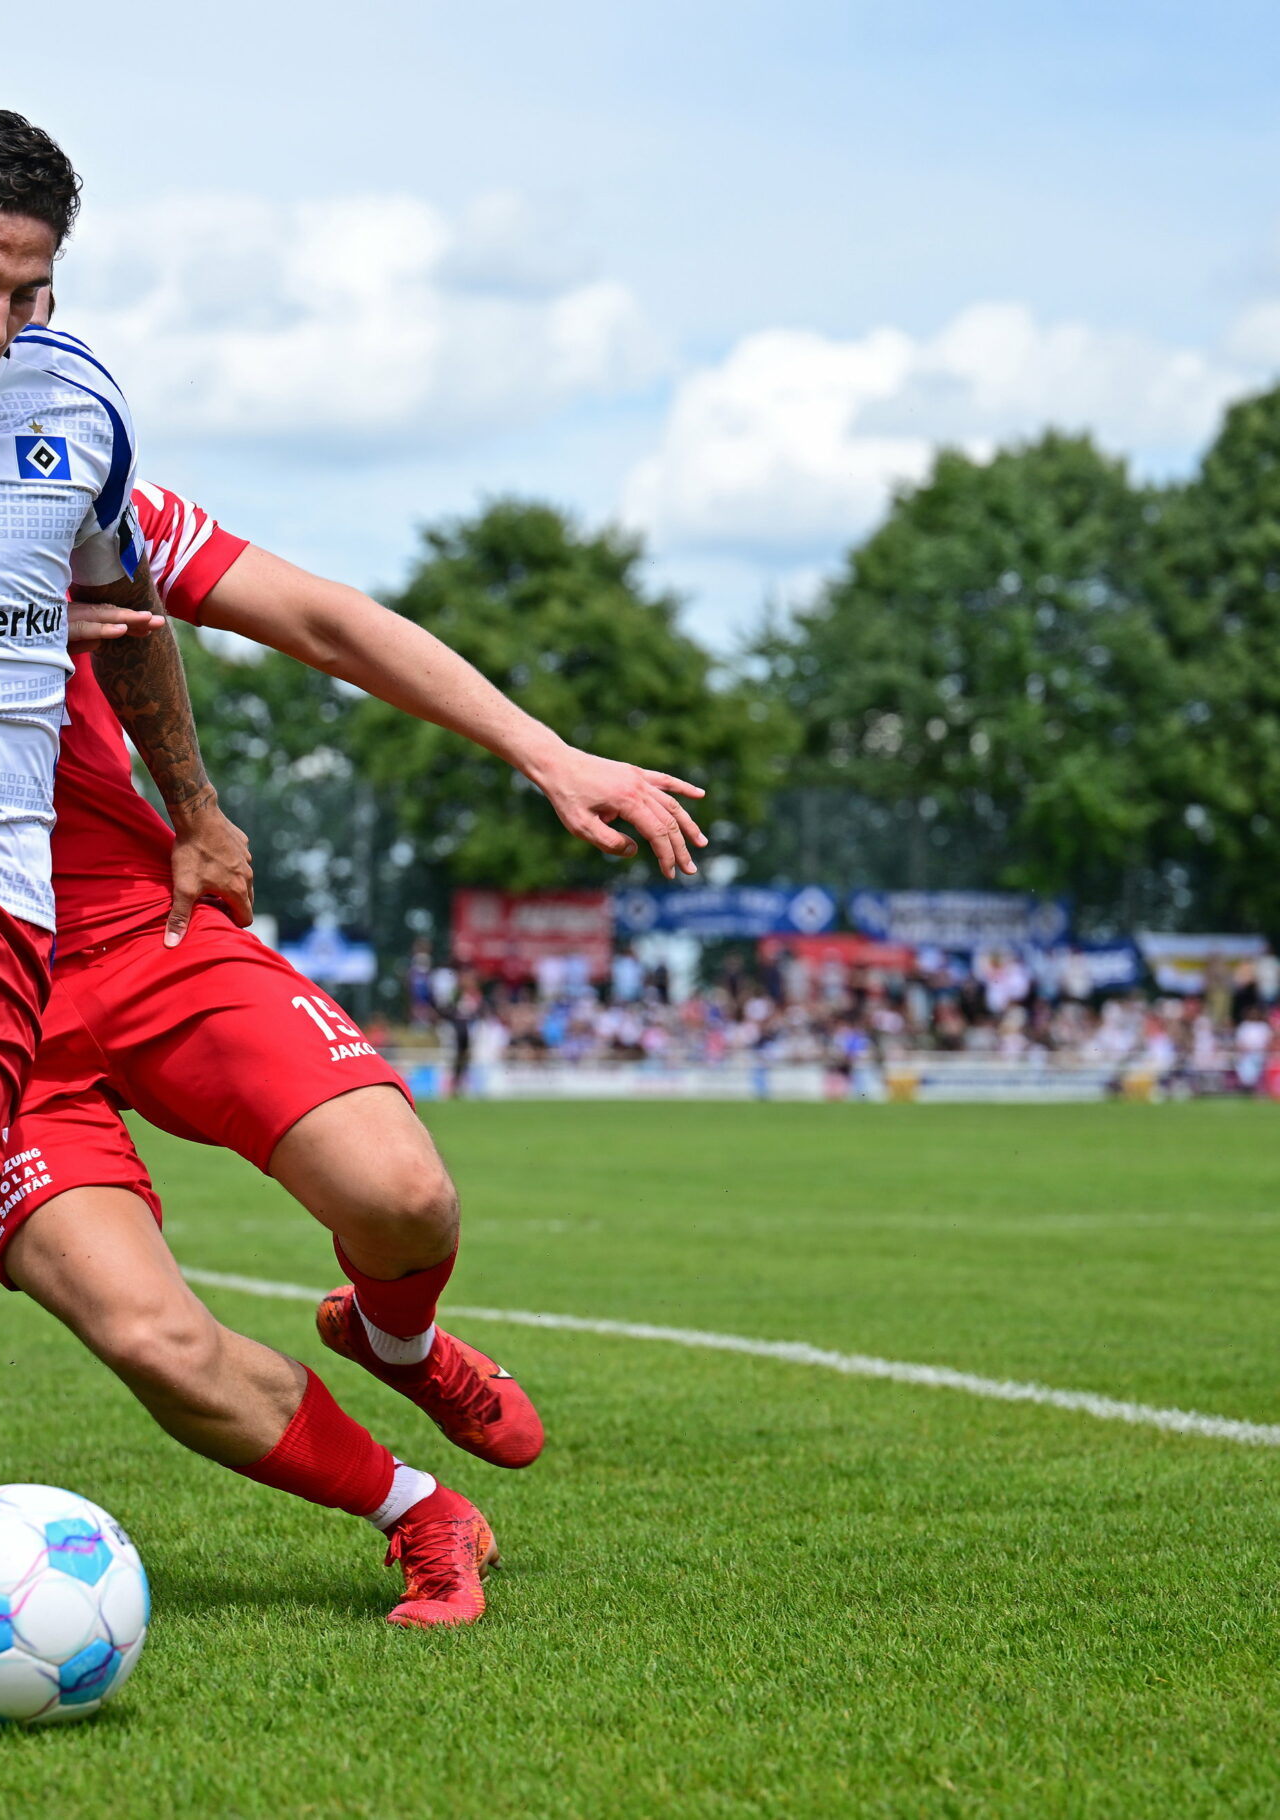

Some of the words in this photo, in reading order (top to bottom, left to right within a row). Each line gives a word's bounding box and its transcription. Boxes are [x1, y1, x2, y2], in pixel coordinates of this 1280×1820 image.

[291, 995, 361, 1041] 15
[328, 1041, 377, 1062] JAKO
[1, 1147, 42, 1176] ZUNG
